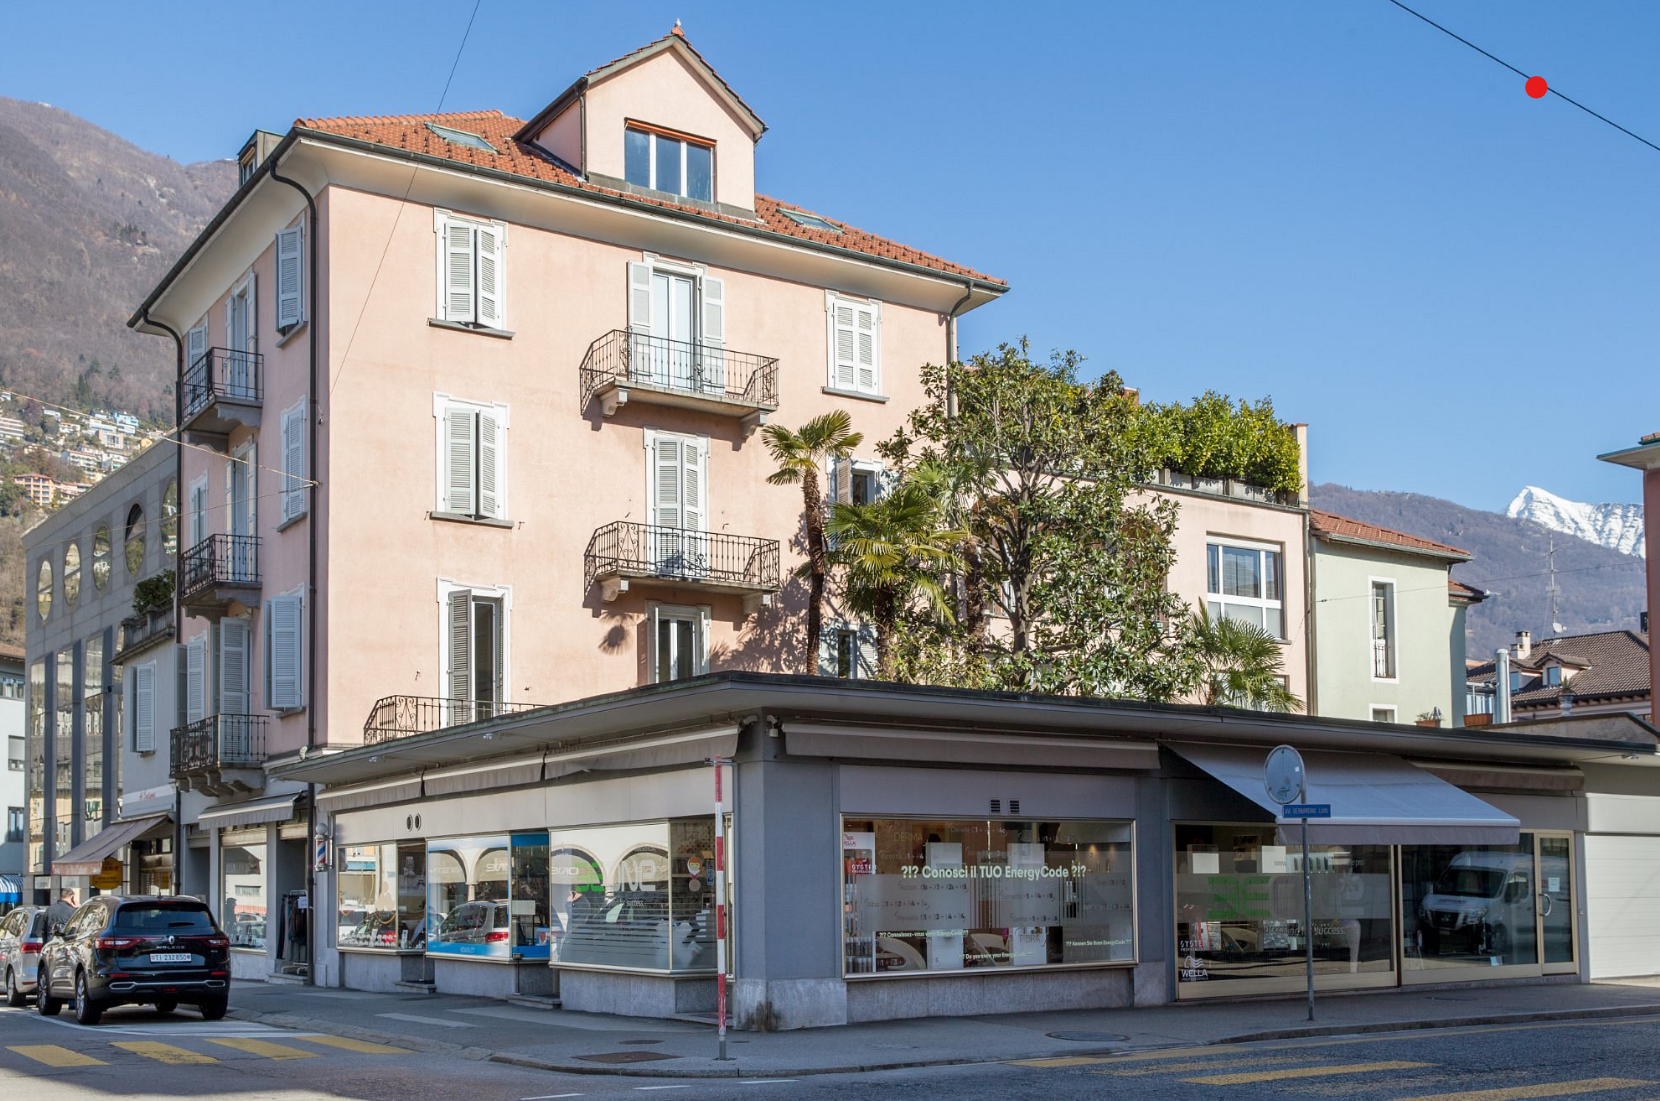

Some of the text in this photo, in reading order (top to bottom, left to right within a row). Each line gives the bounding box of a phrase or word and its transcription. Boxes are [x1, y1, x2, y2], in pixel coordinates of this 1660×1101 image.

[922, 865, 968, 879] Conosci
[970, 865, 977, 879] il
[980, 865, 1002, 878] TUO
[1005, 865, 1069, 881] EnergyCode
[1181, 969, 1208, 978] WELLA
